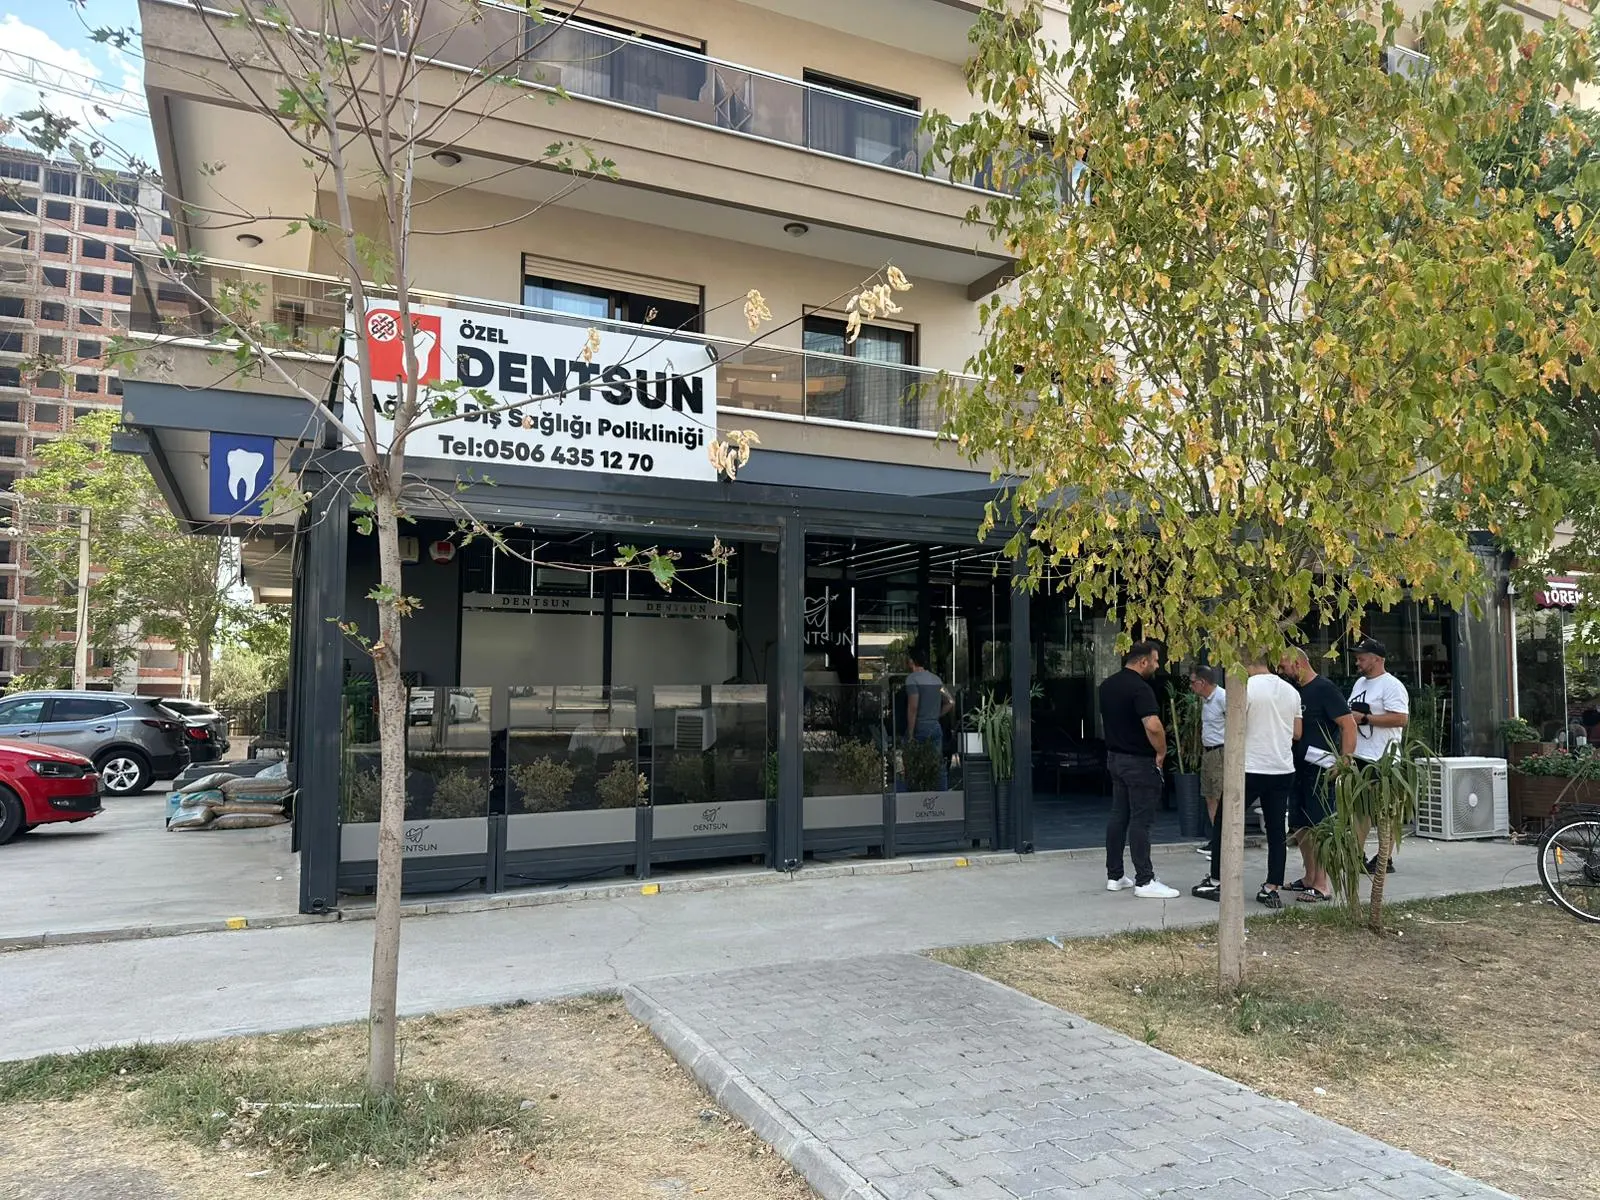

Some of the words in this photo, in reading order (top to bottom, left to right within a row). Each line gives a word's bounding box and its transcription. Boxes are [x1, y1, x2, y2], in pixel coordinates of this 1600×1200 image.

[459, 319, 509, 344] ÖZEL
[457, 345, 703, 414] DENTSUN
[464, 403, 502, 429] Diş
[508, 408, 592, 440] Sağlığı
[598, 418, 703, 450] Polikliniği
[438, 434, 545, 462] Tel:0506
[551, 445, 594, 467] 435
[600, 451, 623, 469] 12
[628, 453, 654, 472] 70
[502, 597, 570, 608] DENTSUN
[693, 823, 728, 831] DENTSUN
